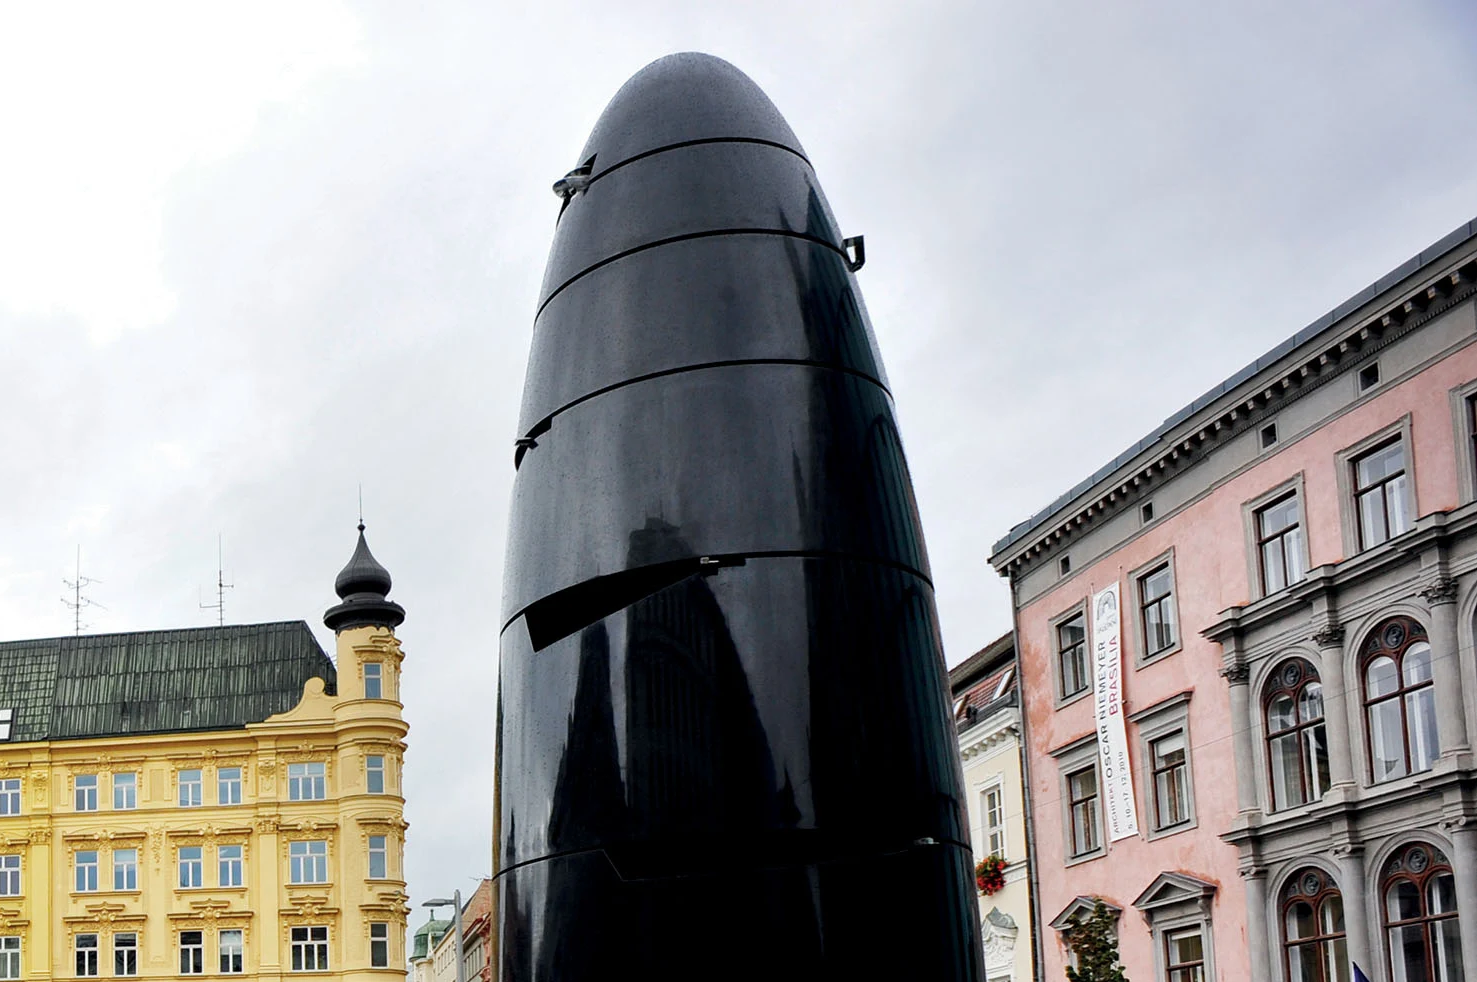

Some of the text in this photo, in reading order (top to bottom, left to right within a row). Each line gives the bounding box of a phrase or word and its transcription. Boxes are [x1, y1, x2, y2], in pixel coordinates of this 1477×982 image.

[1097, 640, 1107, 720] NIEMEYER
[1108, 635, 1119, 716] BRASÍLIA
[1101, 724, 1113, 778] OSCAR
